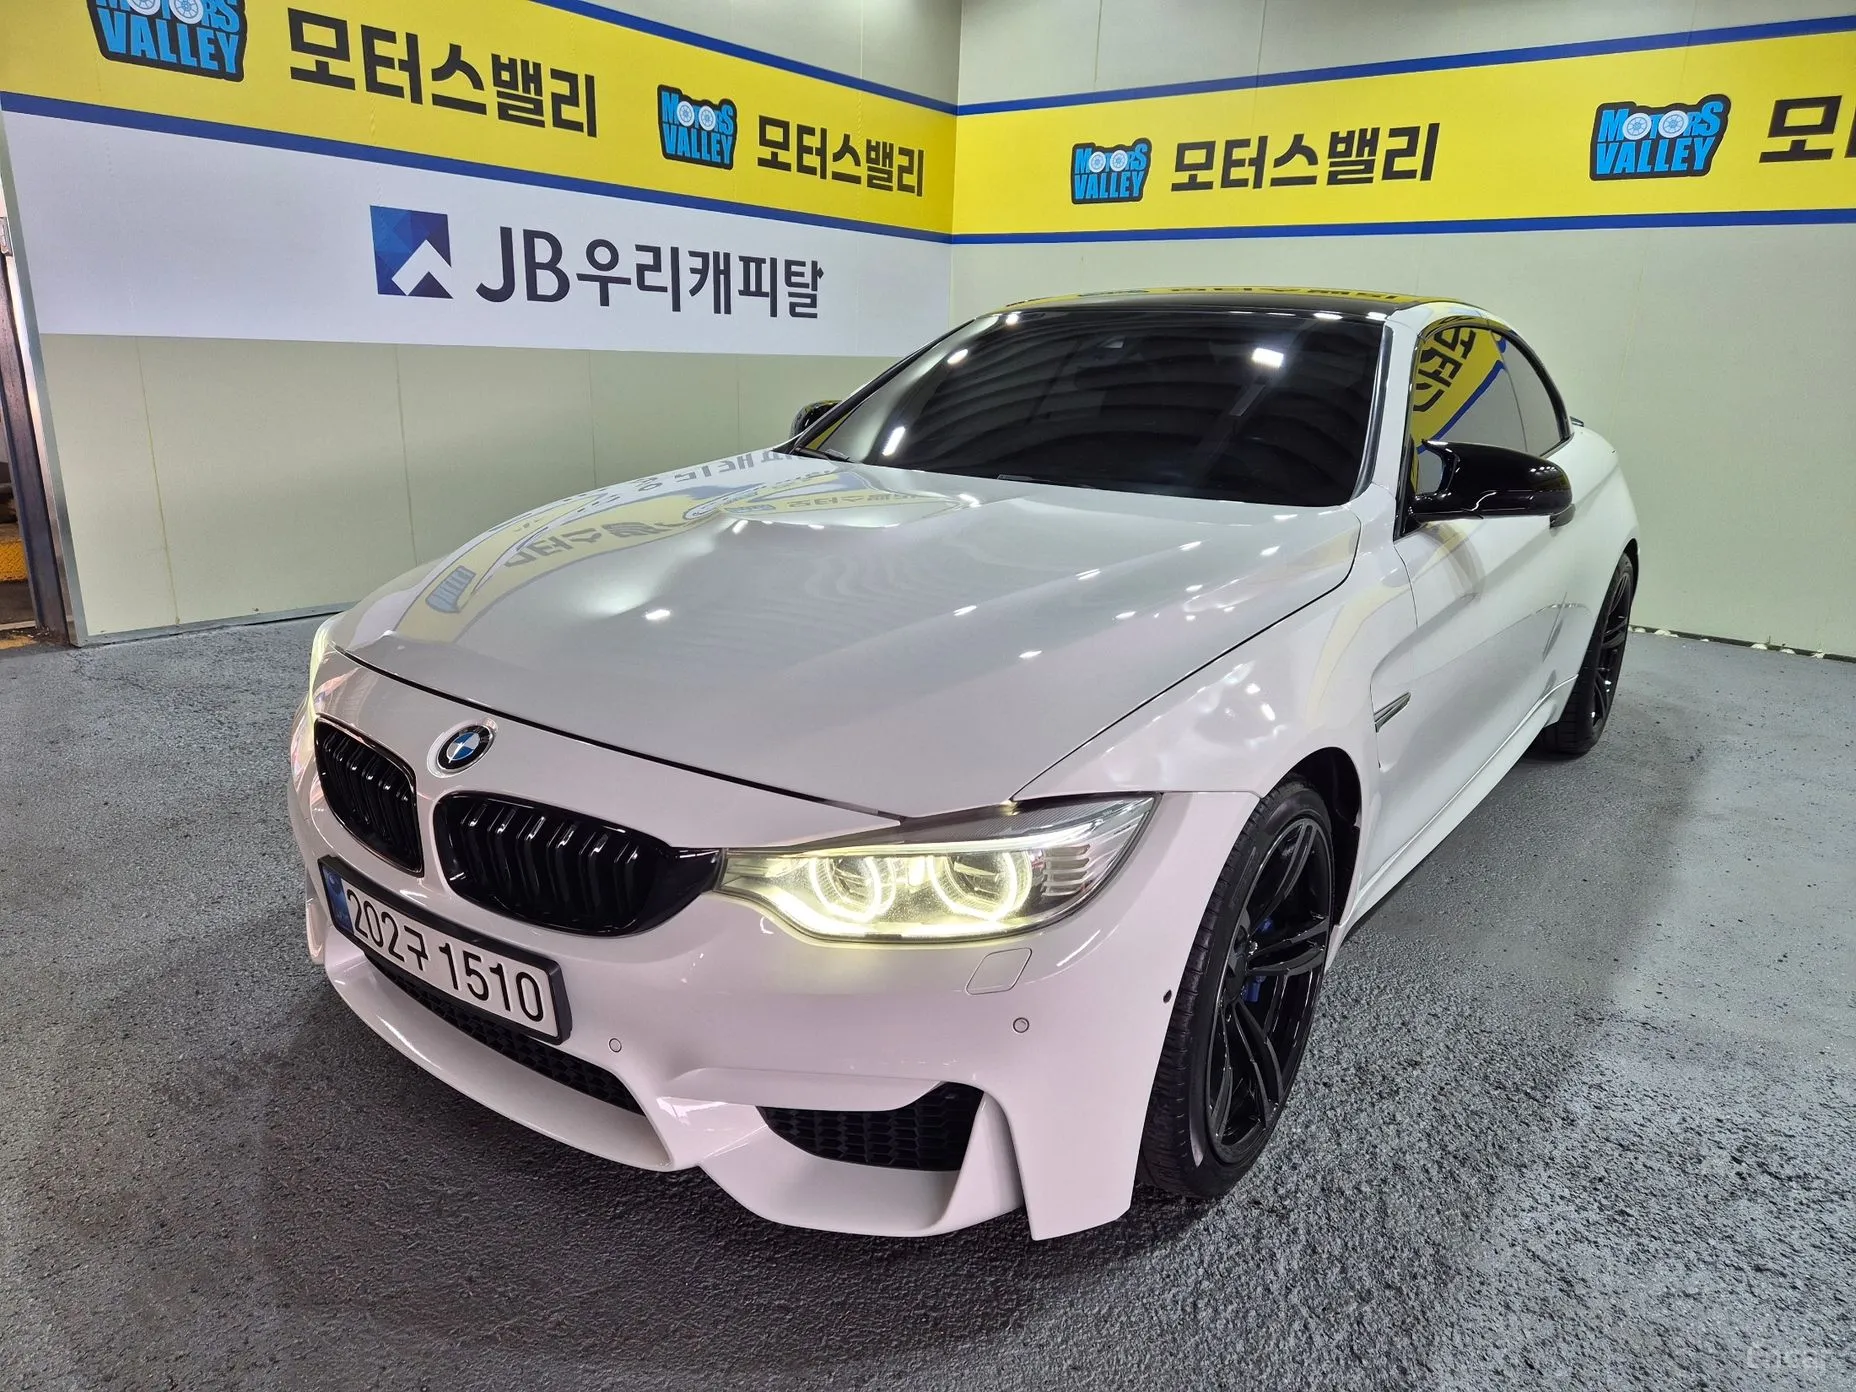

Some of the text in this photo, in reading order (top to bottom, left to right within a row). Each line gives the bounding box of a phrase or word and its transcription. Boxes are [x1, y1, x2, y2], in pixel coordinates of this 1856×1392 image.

[97, 8, 239, 73] VALLEY
[287, 7, 598, 137] 모터스밸리
[661, 91, 734, 135] MOTORS
[662, 123, 733, 165] VALLEY
[1597, 100, 1724, 142] MOTORS
[1759, 95, 1856, 163] 모
[757, 115, 925, 197] 모터스밸리
[1074, 171, 1144, 200] VALLEY
[1075, 143, 1148, 174] MOTORS
[1171, 122, 1440, 191] 모터스밸리
[1596, 136, 1716, 175] VALLEY
[475, 226, 825, 319] JB우리캐피탈
[346, 888, 544, 1022] 202구 1510
